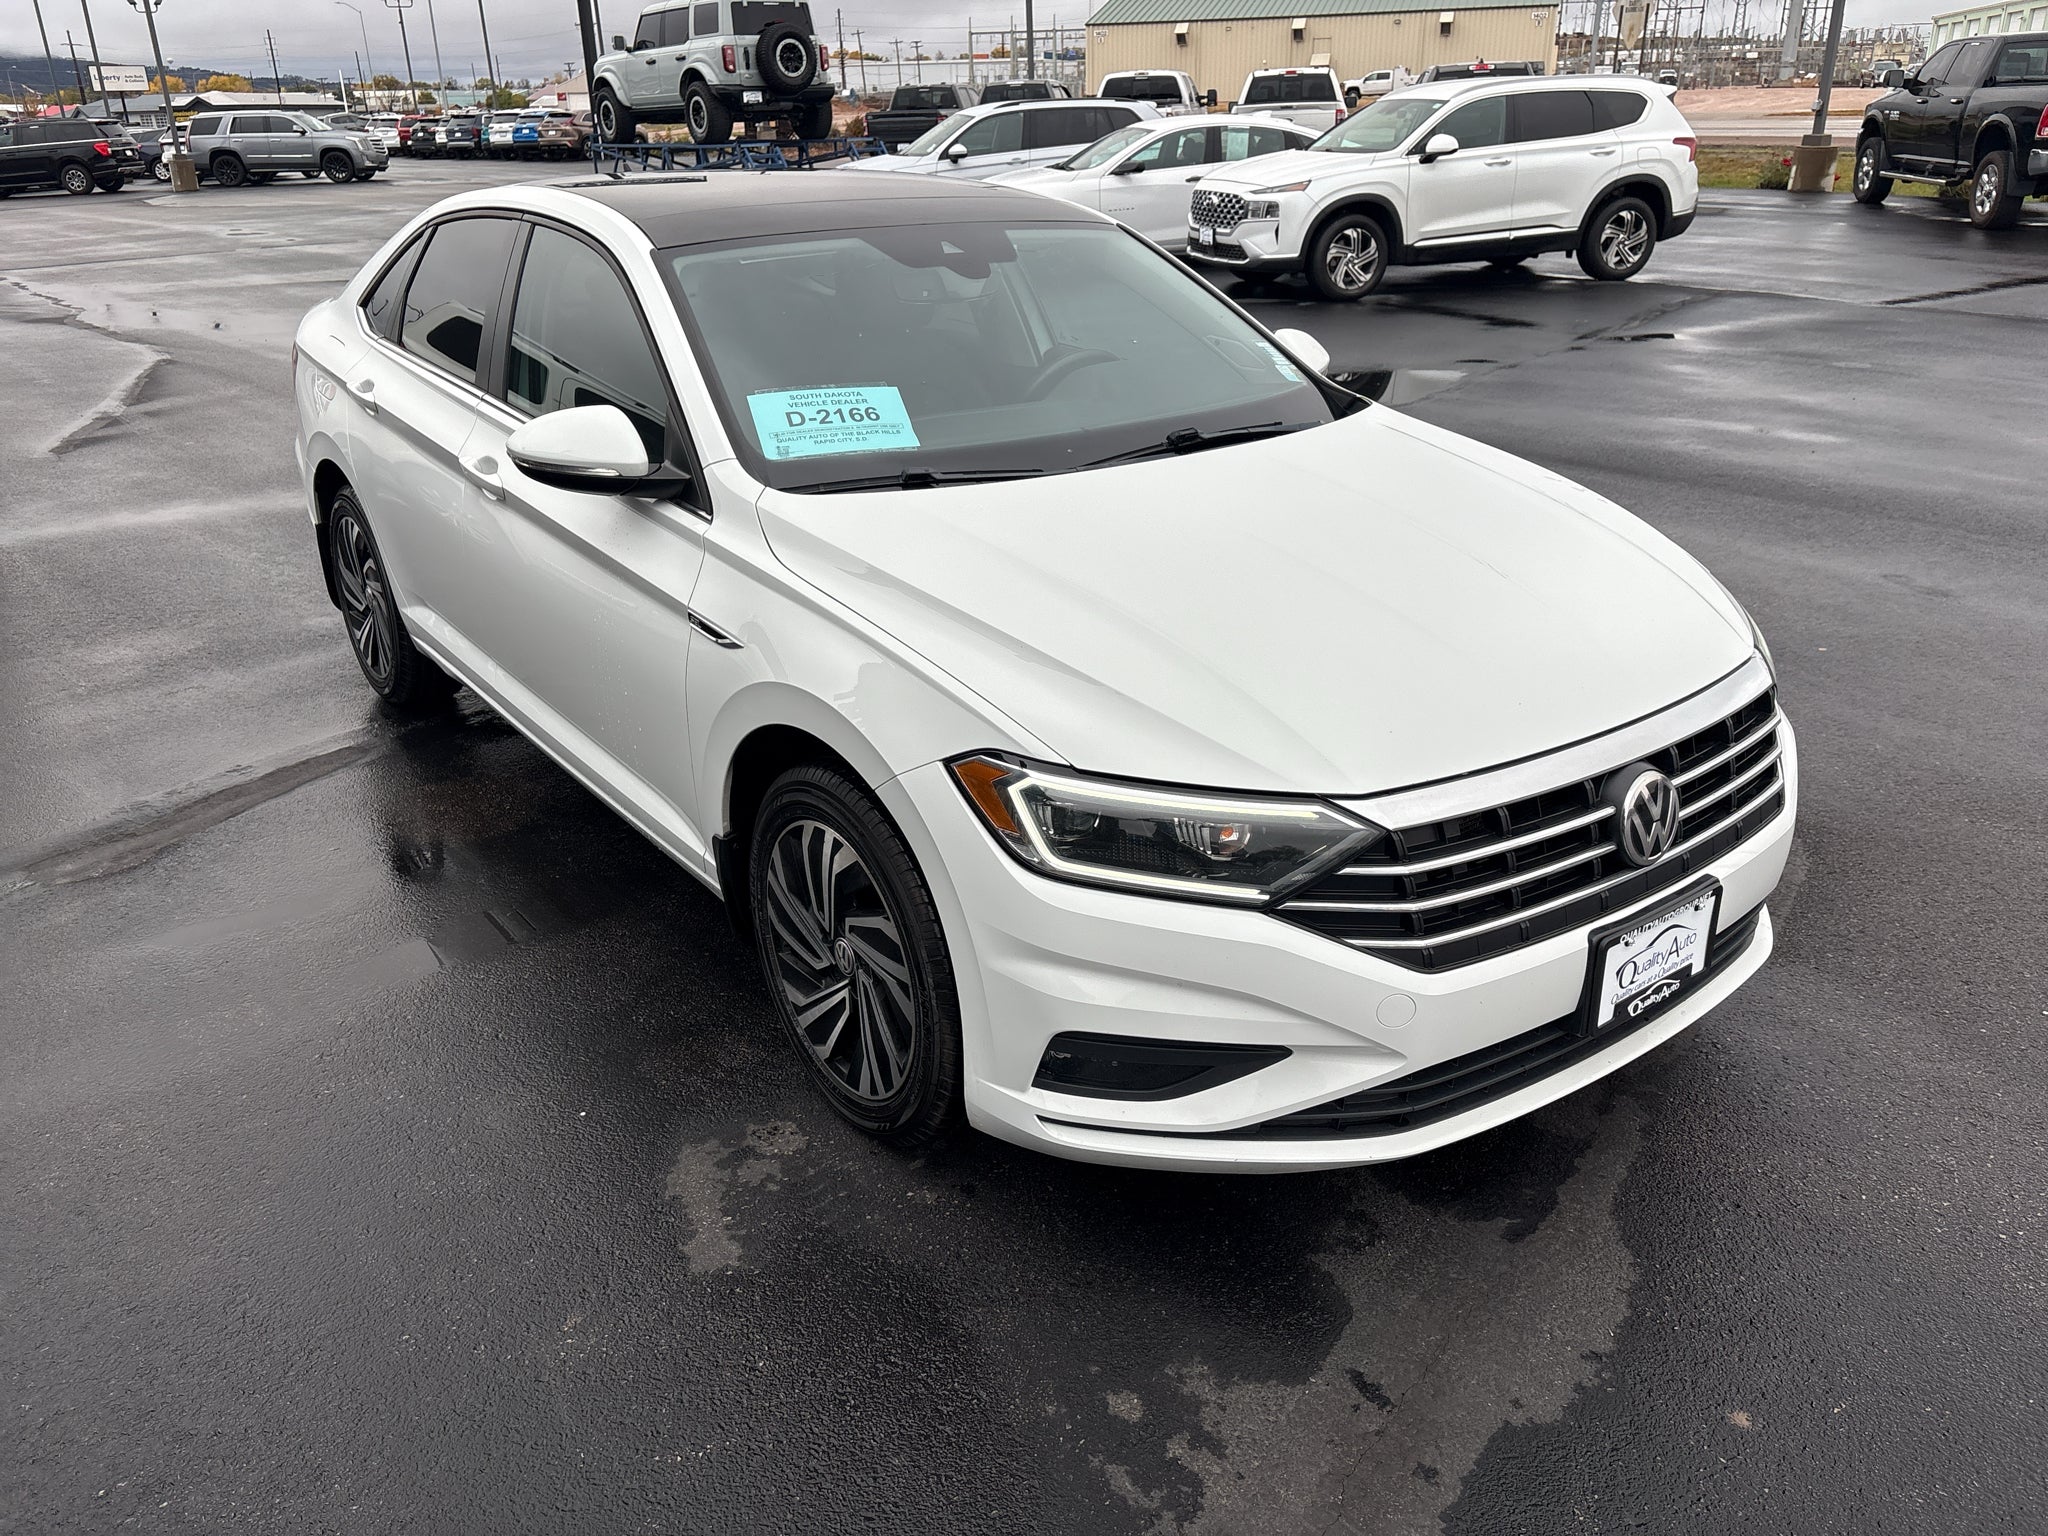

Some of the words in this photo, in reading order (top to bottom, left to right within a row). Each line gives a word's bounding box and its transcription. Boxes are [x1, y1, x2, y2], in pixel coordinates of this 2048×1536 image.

[789, 393, 822, 401] SOUTH
[788, 400, 829, 408] VEHICLE
[785, 406, 881, 428] D-2166
[776, 435, 807, 443] QUALITY
[1611, 987, 1634, 1005] Quality
[1634, 980, 1646, 992] cars
[1658, 962, 1680, 979] Quality
[1680, 953, 1694, 967] price
